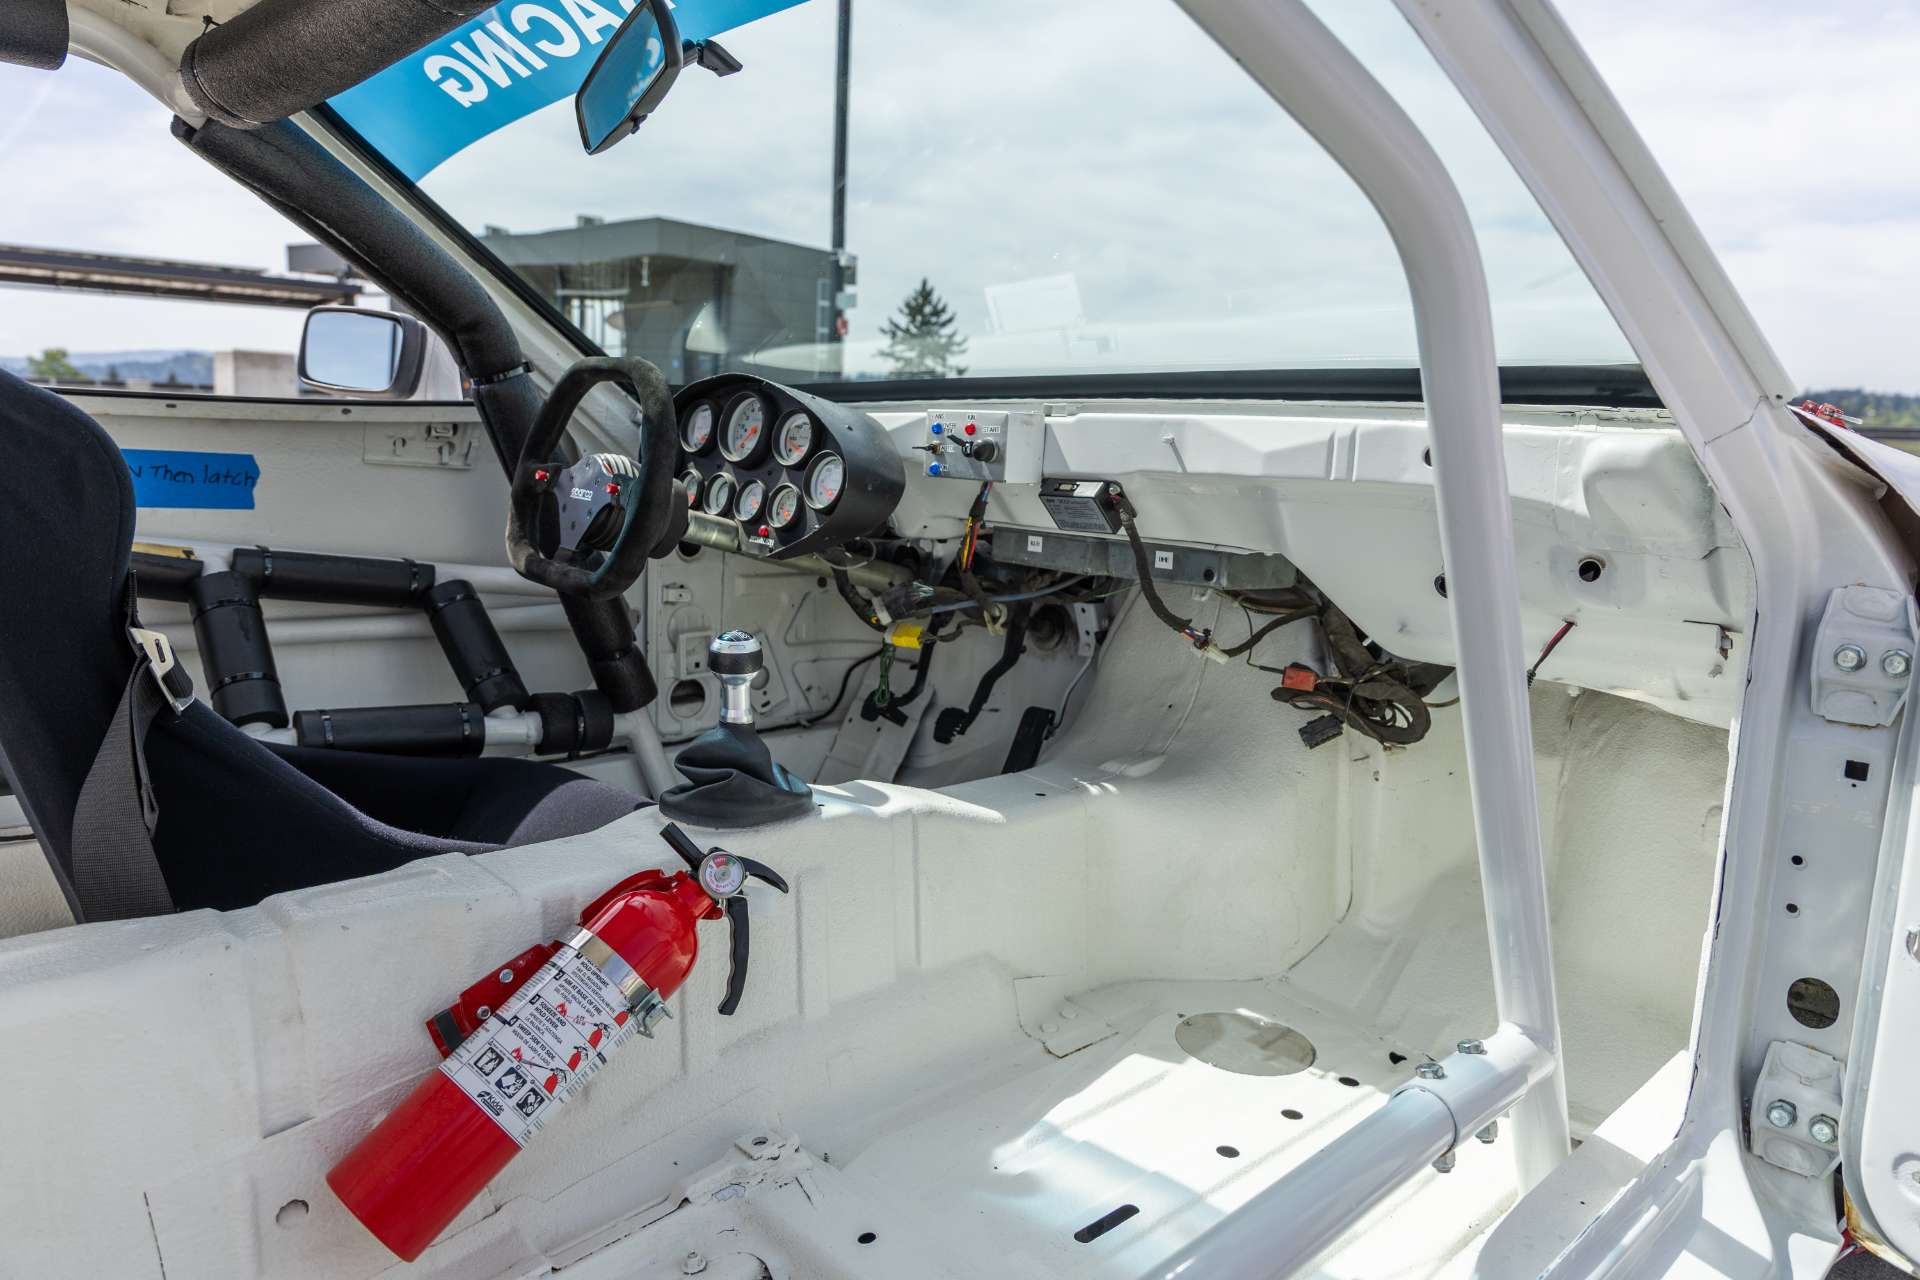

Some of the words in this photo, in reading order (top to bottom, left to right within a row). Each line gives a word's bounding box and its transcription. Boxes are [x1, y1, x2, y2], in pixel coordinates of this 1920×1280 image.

[203, 464, 255, 487] latch
[563, 976, 573, 986] AIM
[576, 988, 588, 1000] BASE
[586, 998, 594, 1006] OF
[534, 1005, 547, 1017] HOLD
[539, 1000, 558, 1018] SQUEEZE
[555, 1016, 566, 1027] AND
[516, 1022, 532, 1036] SWEEP
[529, 1034, 541, 1046] SIDE
[538, 1043, 546, 1051] TO
[487, 1094, 506, 1113] Kidde
